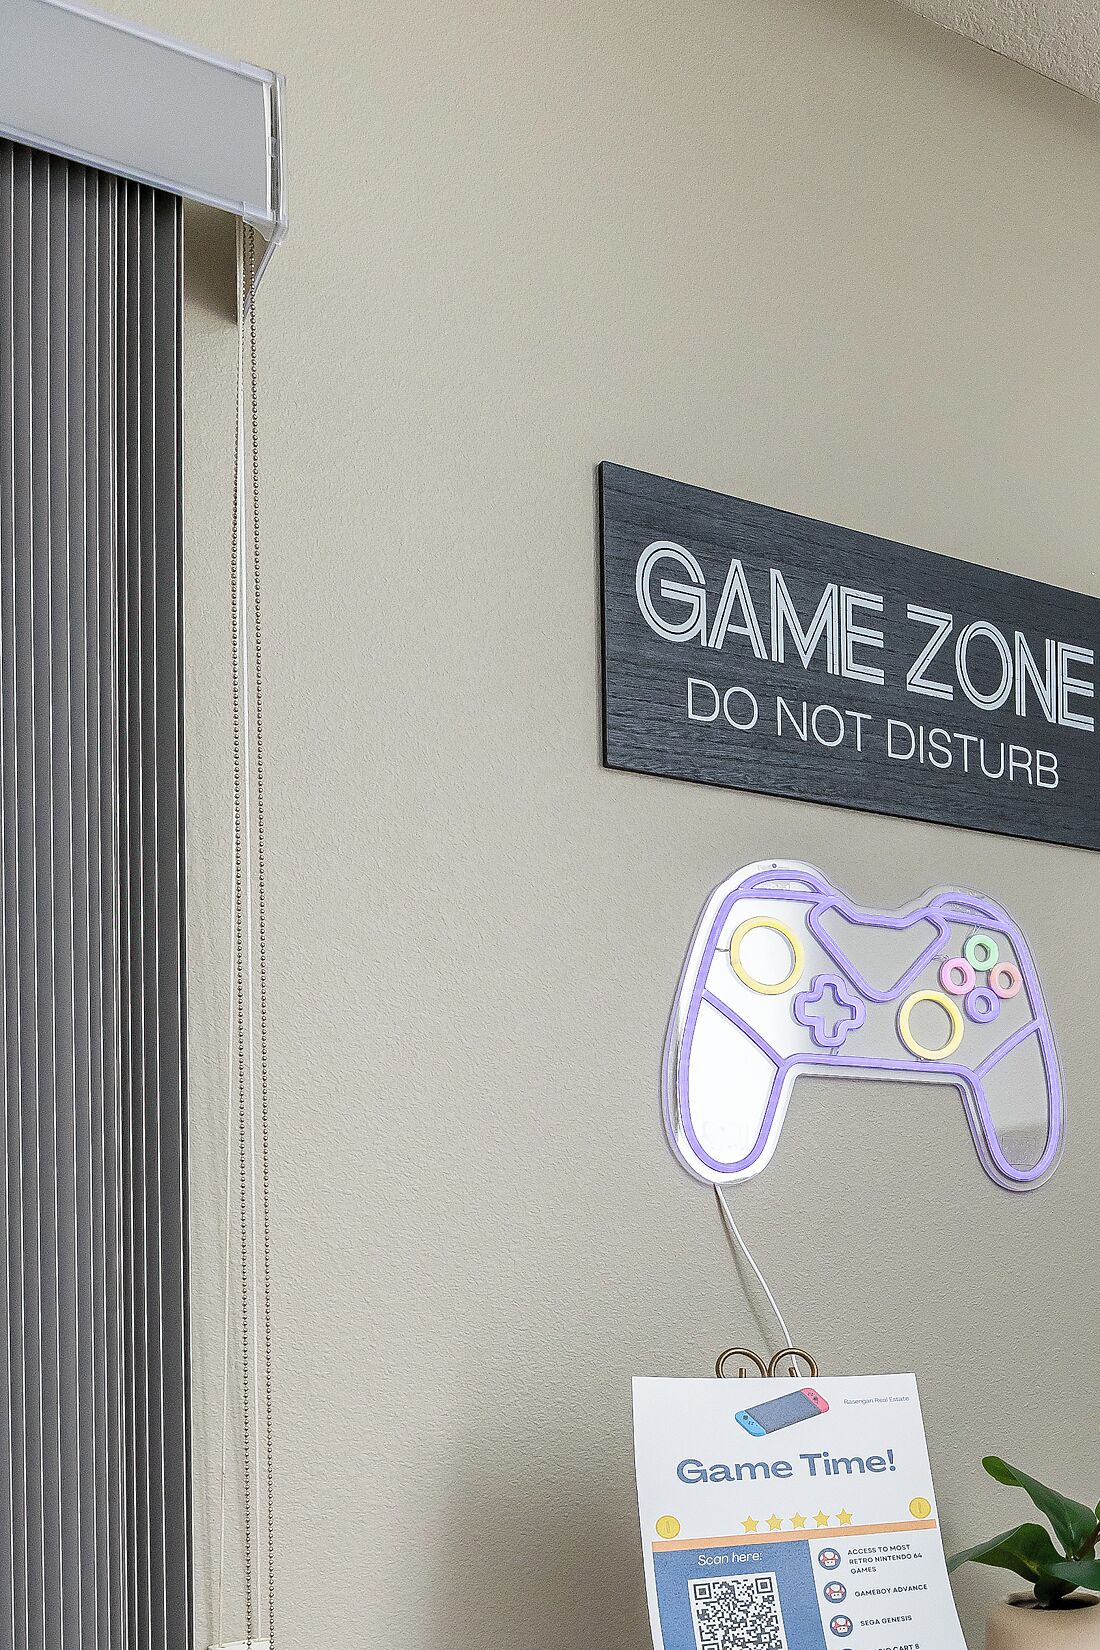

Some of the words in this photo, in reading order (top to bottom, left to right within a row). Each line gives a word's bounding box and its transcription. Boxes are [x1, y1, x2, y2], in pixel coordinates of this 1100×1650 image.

[635, 540, 885, 685] GAME
[906, 602, 1095, 733] ZONE
[687, 677, 759, 731] DO
[775, 695, 872, 752] NOT
[887, 718, 1060, 790] DISTURB
[676, 1457, 793, 1485] Game
[799, 1448, 897, 1477] Time!
[847, 1547, 877, 1556] ACCESS
[889, 1544, 911, 1552] MOST
[697, 1554, 729, 1566] Scan
[731, 1551, 763, 1563] here:
[848, 1557, 874, 1565] RETRO
[874, 1553, 912, 1562] NINTENDO
[850, 1566, 877, 1575] GAMES
[854, 1587, 891, 1598] GAMEBOY
[892, 1583, 928, 1593] ADVANCE
[860, 1619, 881, 1627] SEGA
[881, 1614, 913, 1624] GENESIS
